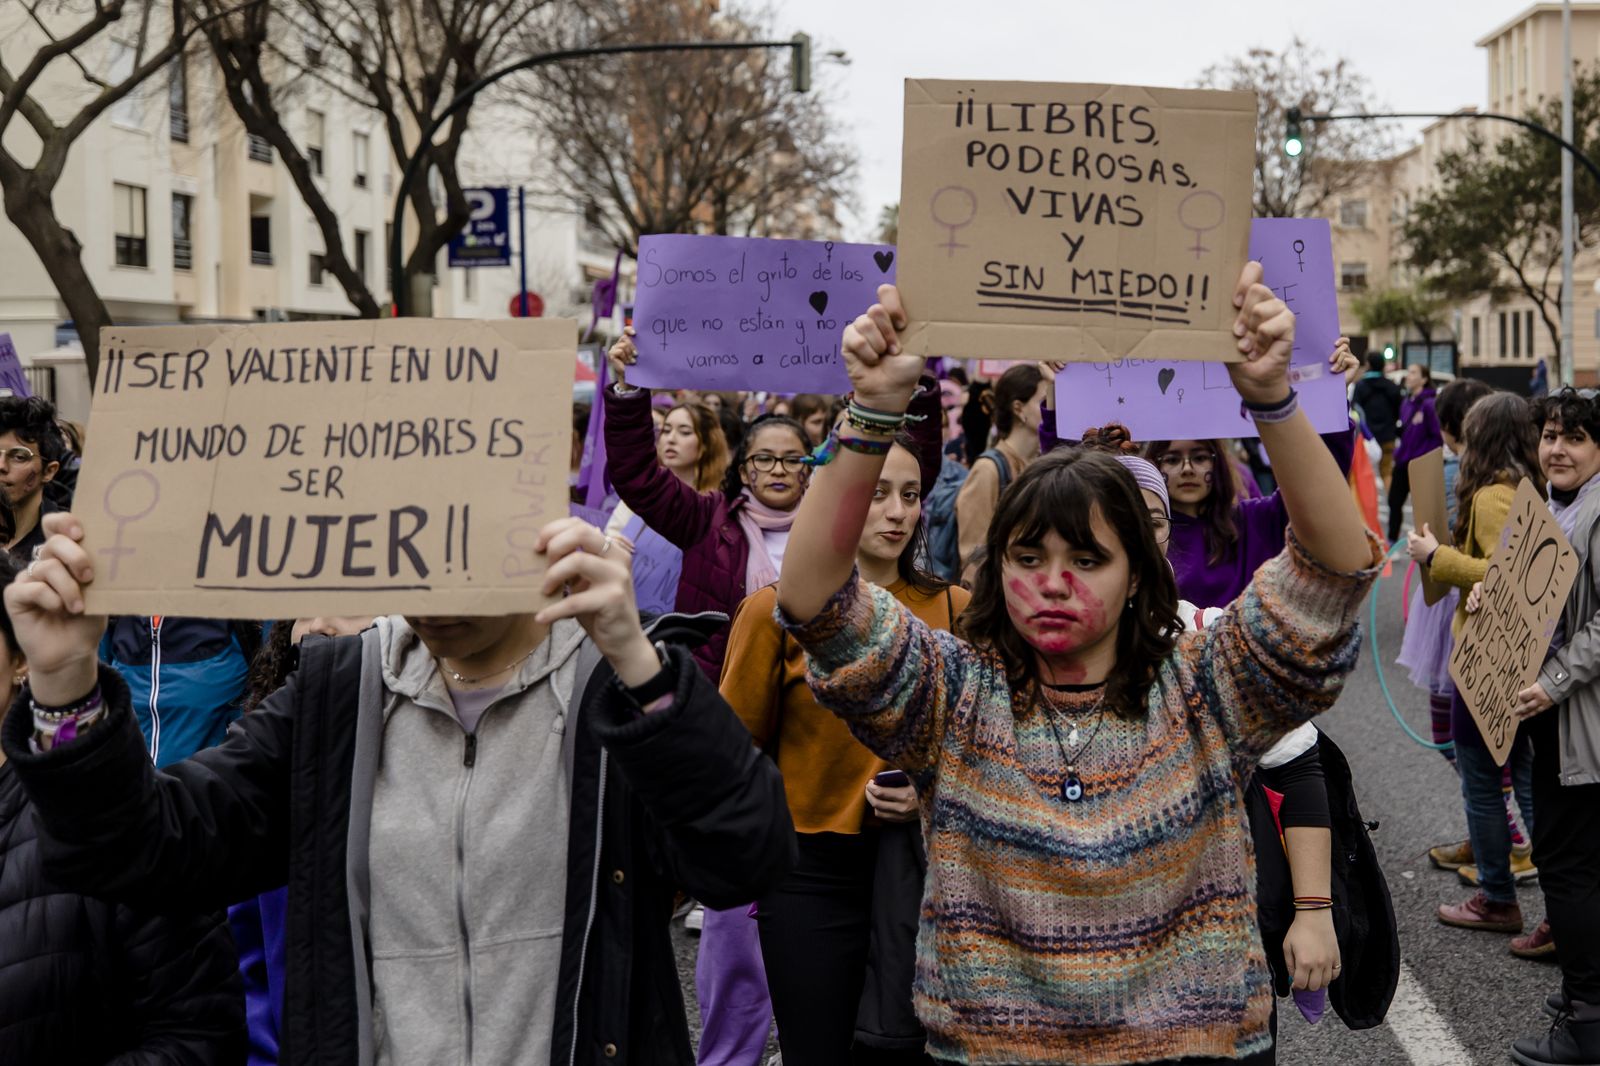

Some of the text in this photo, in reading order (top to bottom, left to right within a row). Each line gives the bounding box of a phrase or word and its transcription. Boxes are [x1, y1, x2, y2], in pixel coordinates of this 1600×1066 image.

[955, 88, 1160, 146] ¡¡LIBRES,
[966, 140, 1198, 188] PODEROSAS,
[1005, 186, 1144, 227] VIVAS
[1061, 231, 1086, 263] Y
[643, 249, 717, 287] Somos
[728, 251, 746, 284] el
[757, 251, 797, 302] grito
[812, 262, 833, 281] de
[979, 261, 1210, 311] SIN MIEDO!!
[652, 306, 836, 351] que no están y no
[102, 336, 498, 394] ¡¡SER VALIENTE EN UN
[686, 344, 838, 369] vamos a callar!
[134, 416, 524, 463] MUNDO DE HOMBRES ES
[279, 466, 344, 499] SER
[195, 504, 473, 582] MUJER!!
[1509, 511, 1559, 607] NO
[1484, 564, 1538, 672] CALLADITAS
[1472, 603, 1525, 708] NO ESTAMOS
[1474, 672, 1511, 749] GUAPAS
